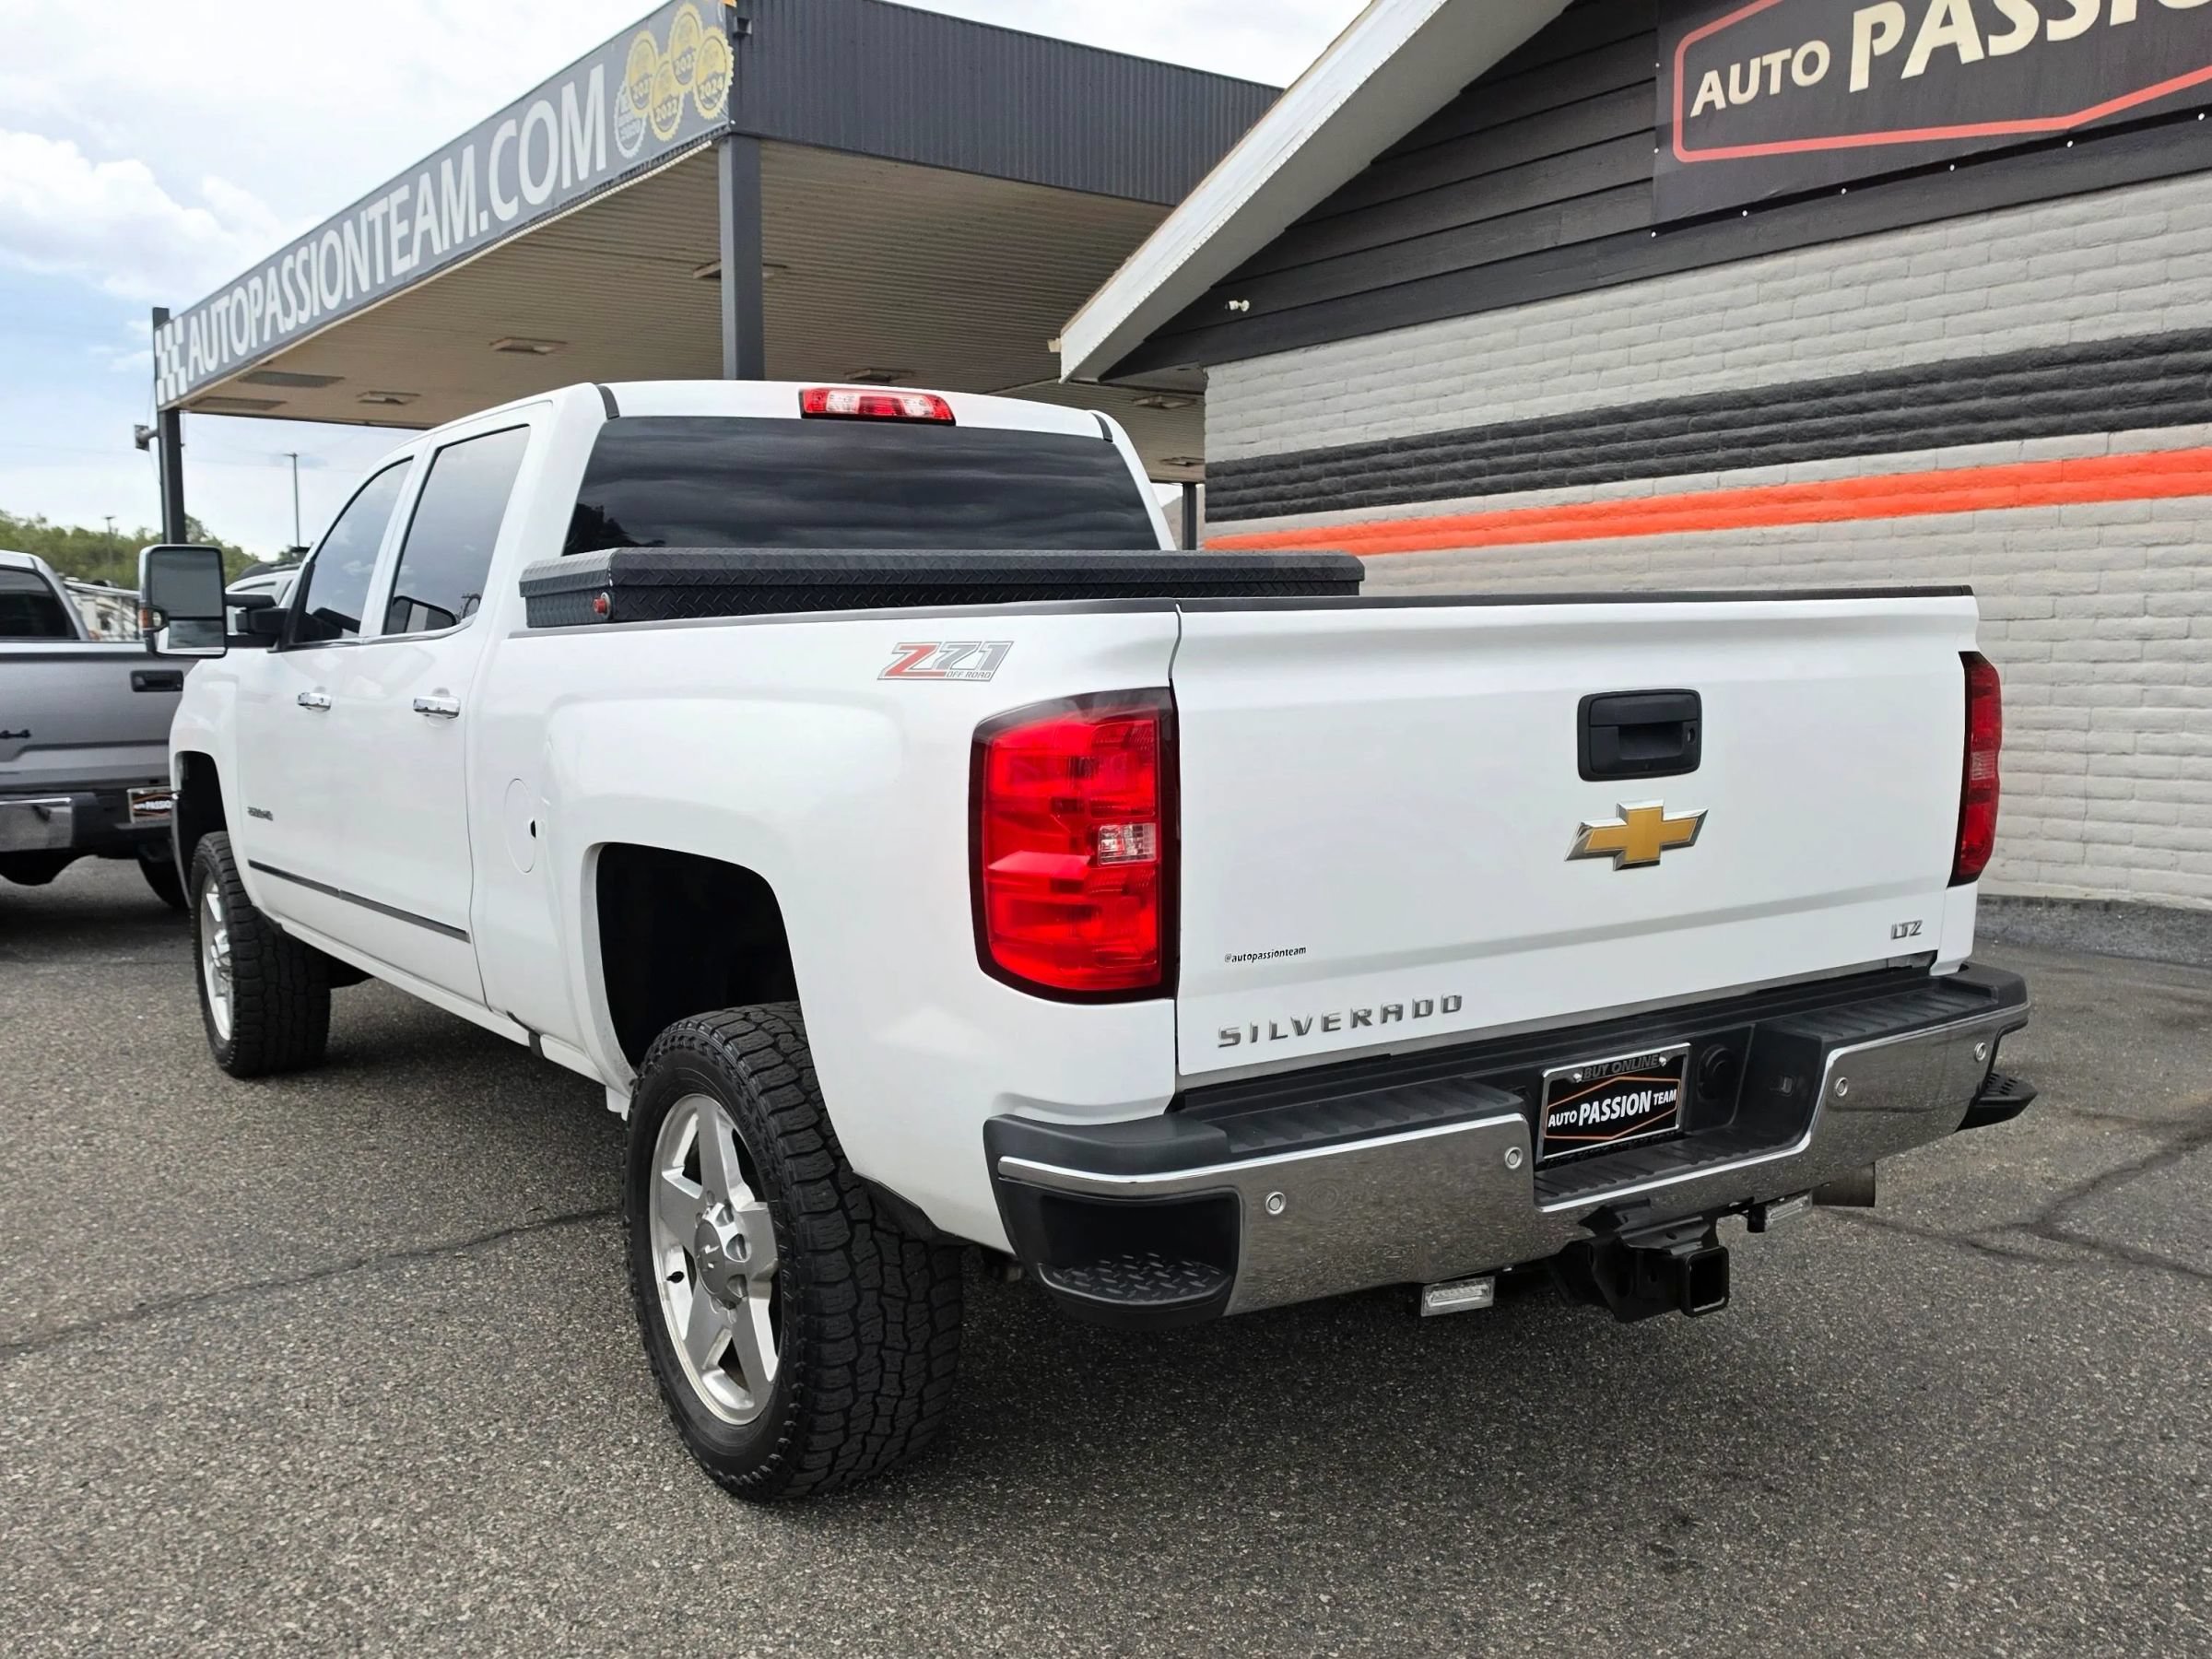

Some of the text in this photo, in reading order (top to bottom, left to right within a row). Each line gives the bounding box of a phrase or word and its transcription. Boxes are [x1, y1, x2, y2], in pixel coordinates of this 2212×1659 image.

[1689, 40, 1830, 117] AUTO
[187, 64, 606, 382] AUTOPASSIONTEAM.COM
[877, 641, 1014, 681] Z71
[946, 670, 992, 679] OFF ROAD
[1890, 920, 1923, 940] LTZ
[1224, 946, 1307, 963] @autopassionteam
[1217, 993, 1463, 1049] SILVERADO
[1584, 1054, 1660, 1079] BUY ONLINE
[1547, 1088, 1677, 1128] AUTO PASSION TEAM
